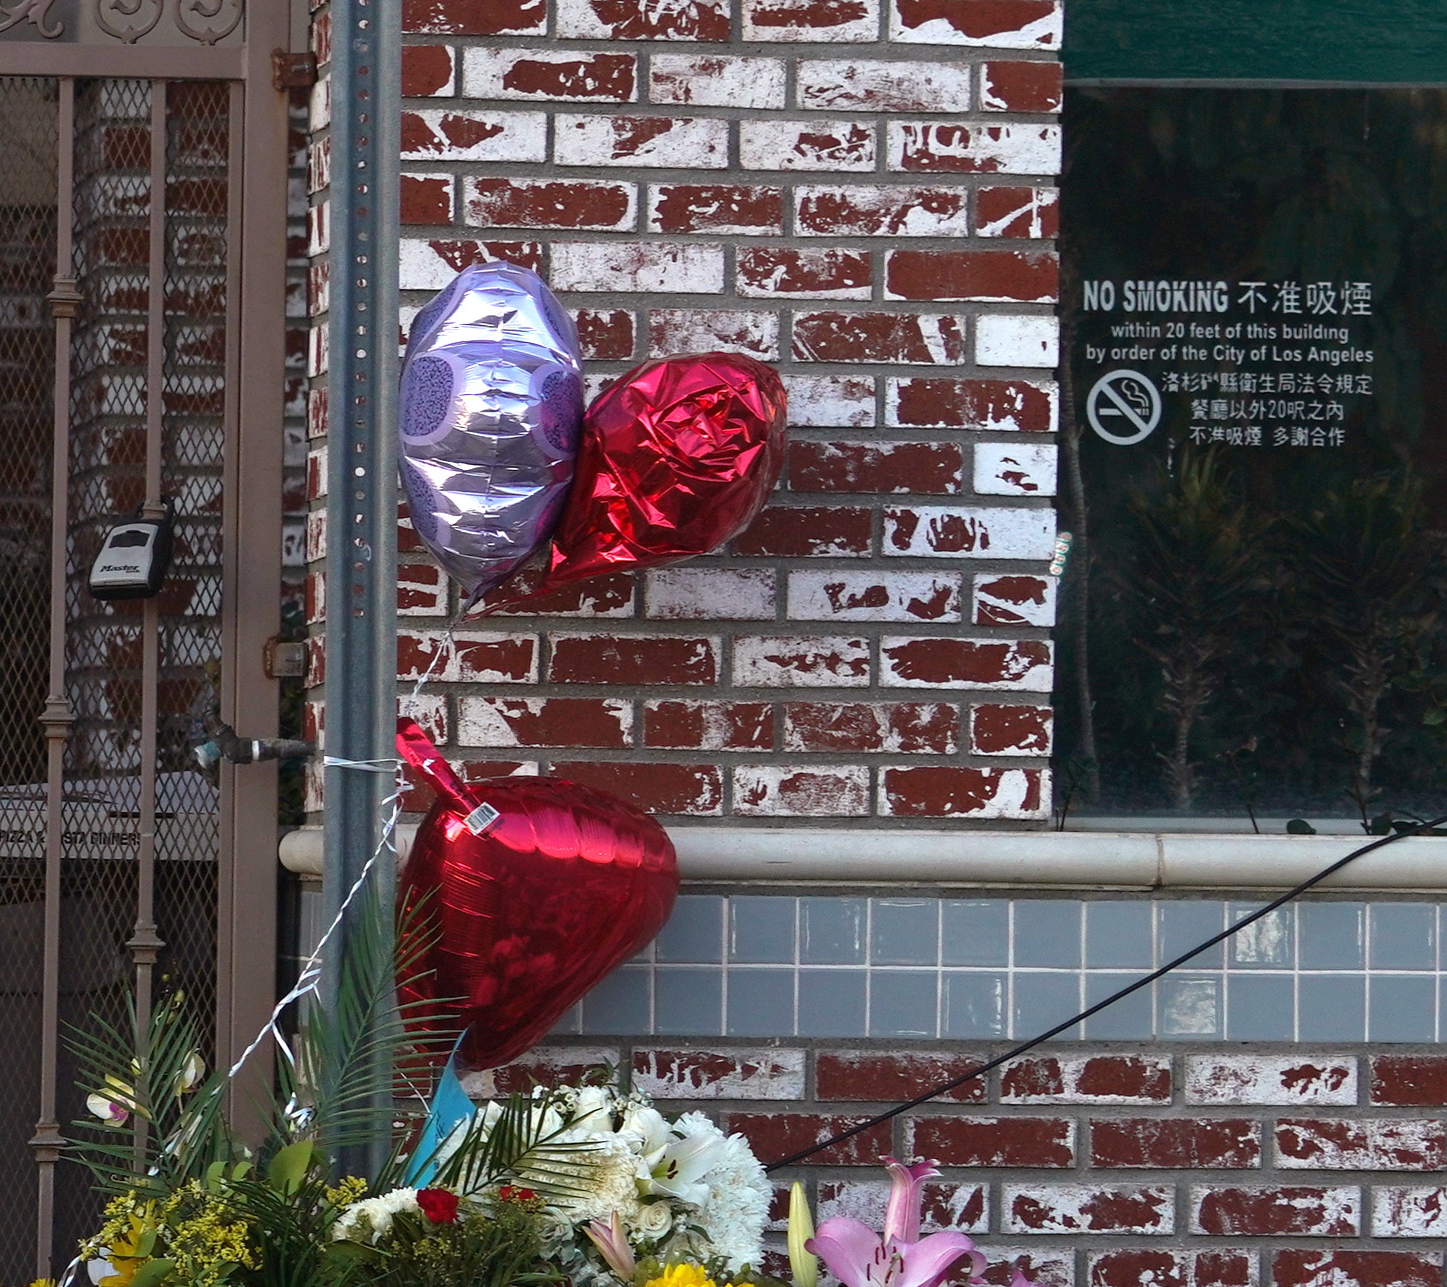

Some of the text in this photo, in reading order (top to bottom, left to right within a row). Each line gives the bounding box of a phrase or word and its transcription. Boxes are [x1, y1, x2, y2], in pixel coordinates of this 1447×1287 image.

[1083, 280, 1372, 316] NO SMOKING 不准吸煙
[1110, 321, 1349, 345] within 20 feet of this building
[1086, 344, 1374, 367] by order of the City of Los Angeles
[99, 564, 140, 573] Master
